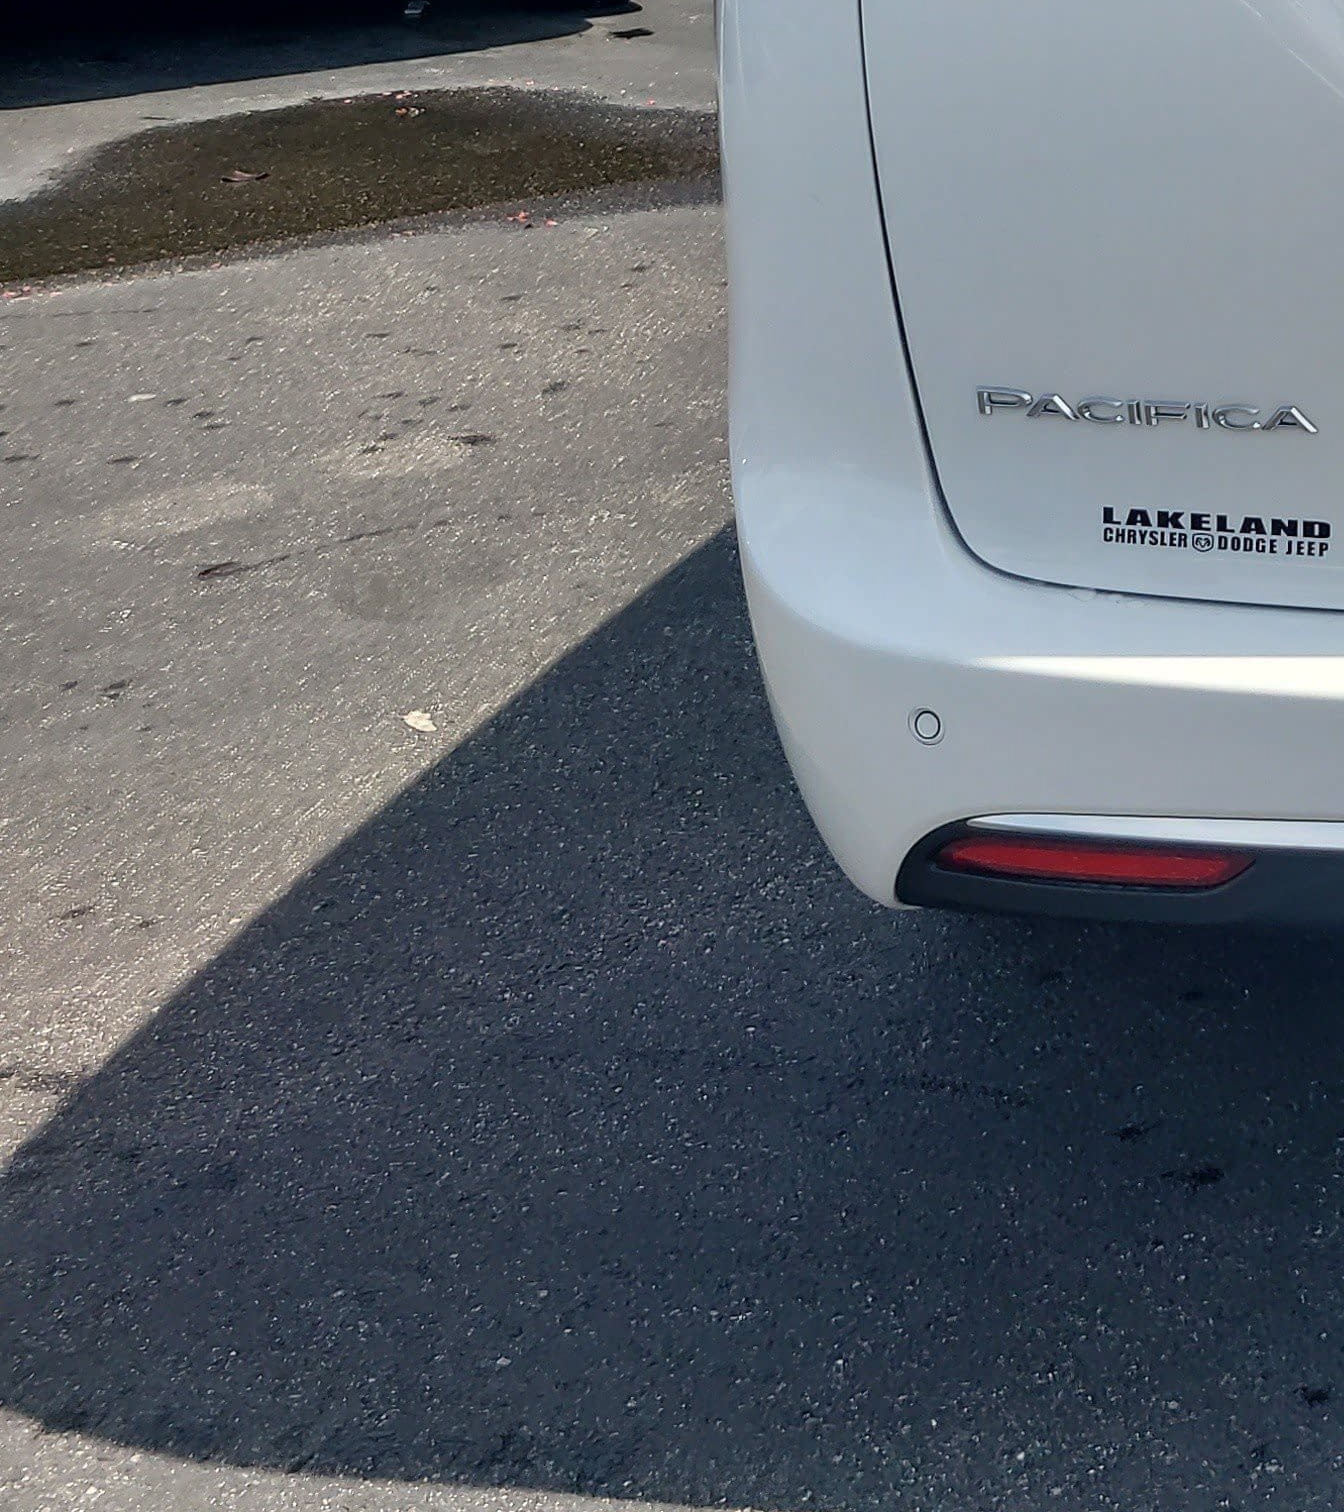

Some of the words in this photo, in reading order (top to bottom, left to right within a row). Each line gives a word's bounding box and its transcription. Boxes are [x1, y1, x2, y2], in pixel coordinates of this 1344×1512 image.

[976, 385, 1319, 433] PACIFICA
[1102, 506, 1332, 539] LAKELAND
[1103, 527, 1188, 548] CHRYSLER
[1217, 538, 1278, 554] DODGE
[1285, 540, 1330, 557] JEEP
